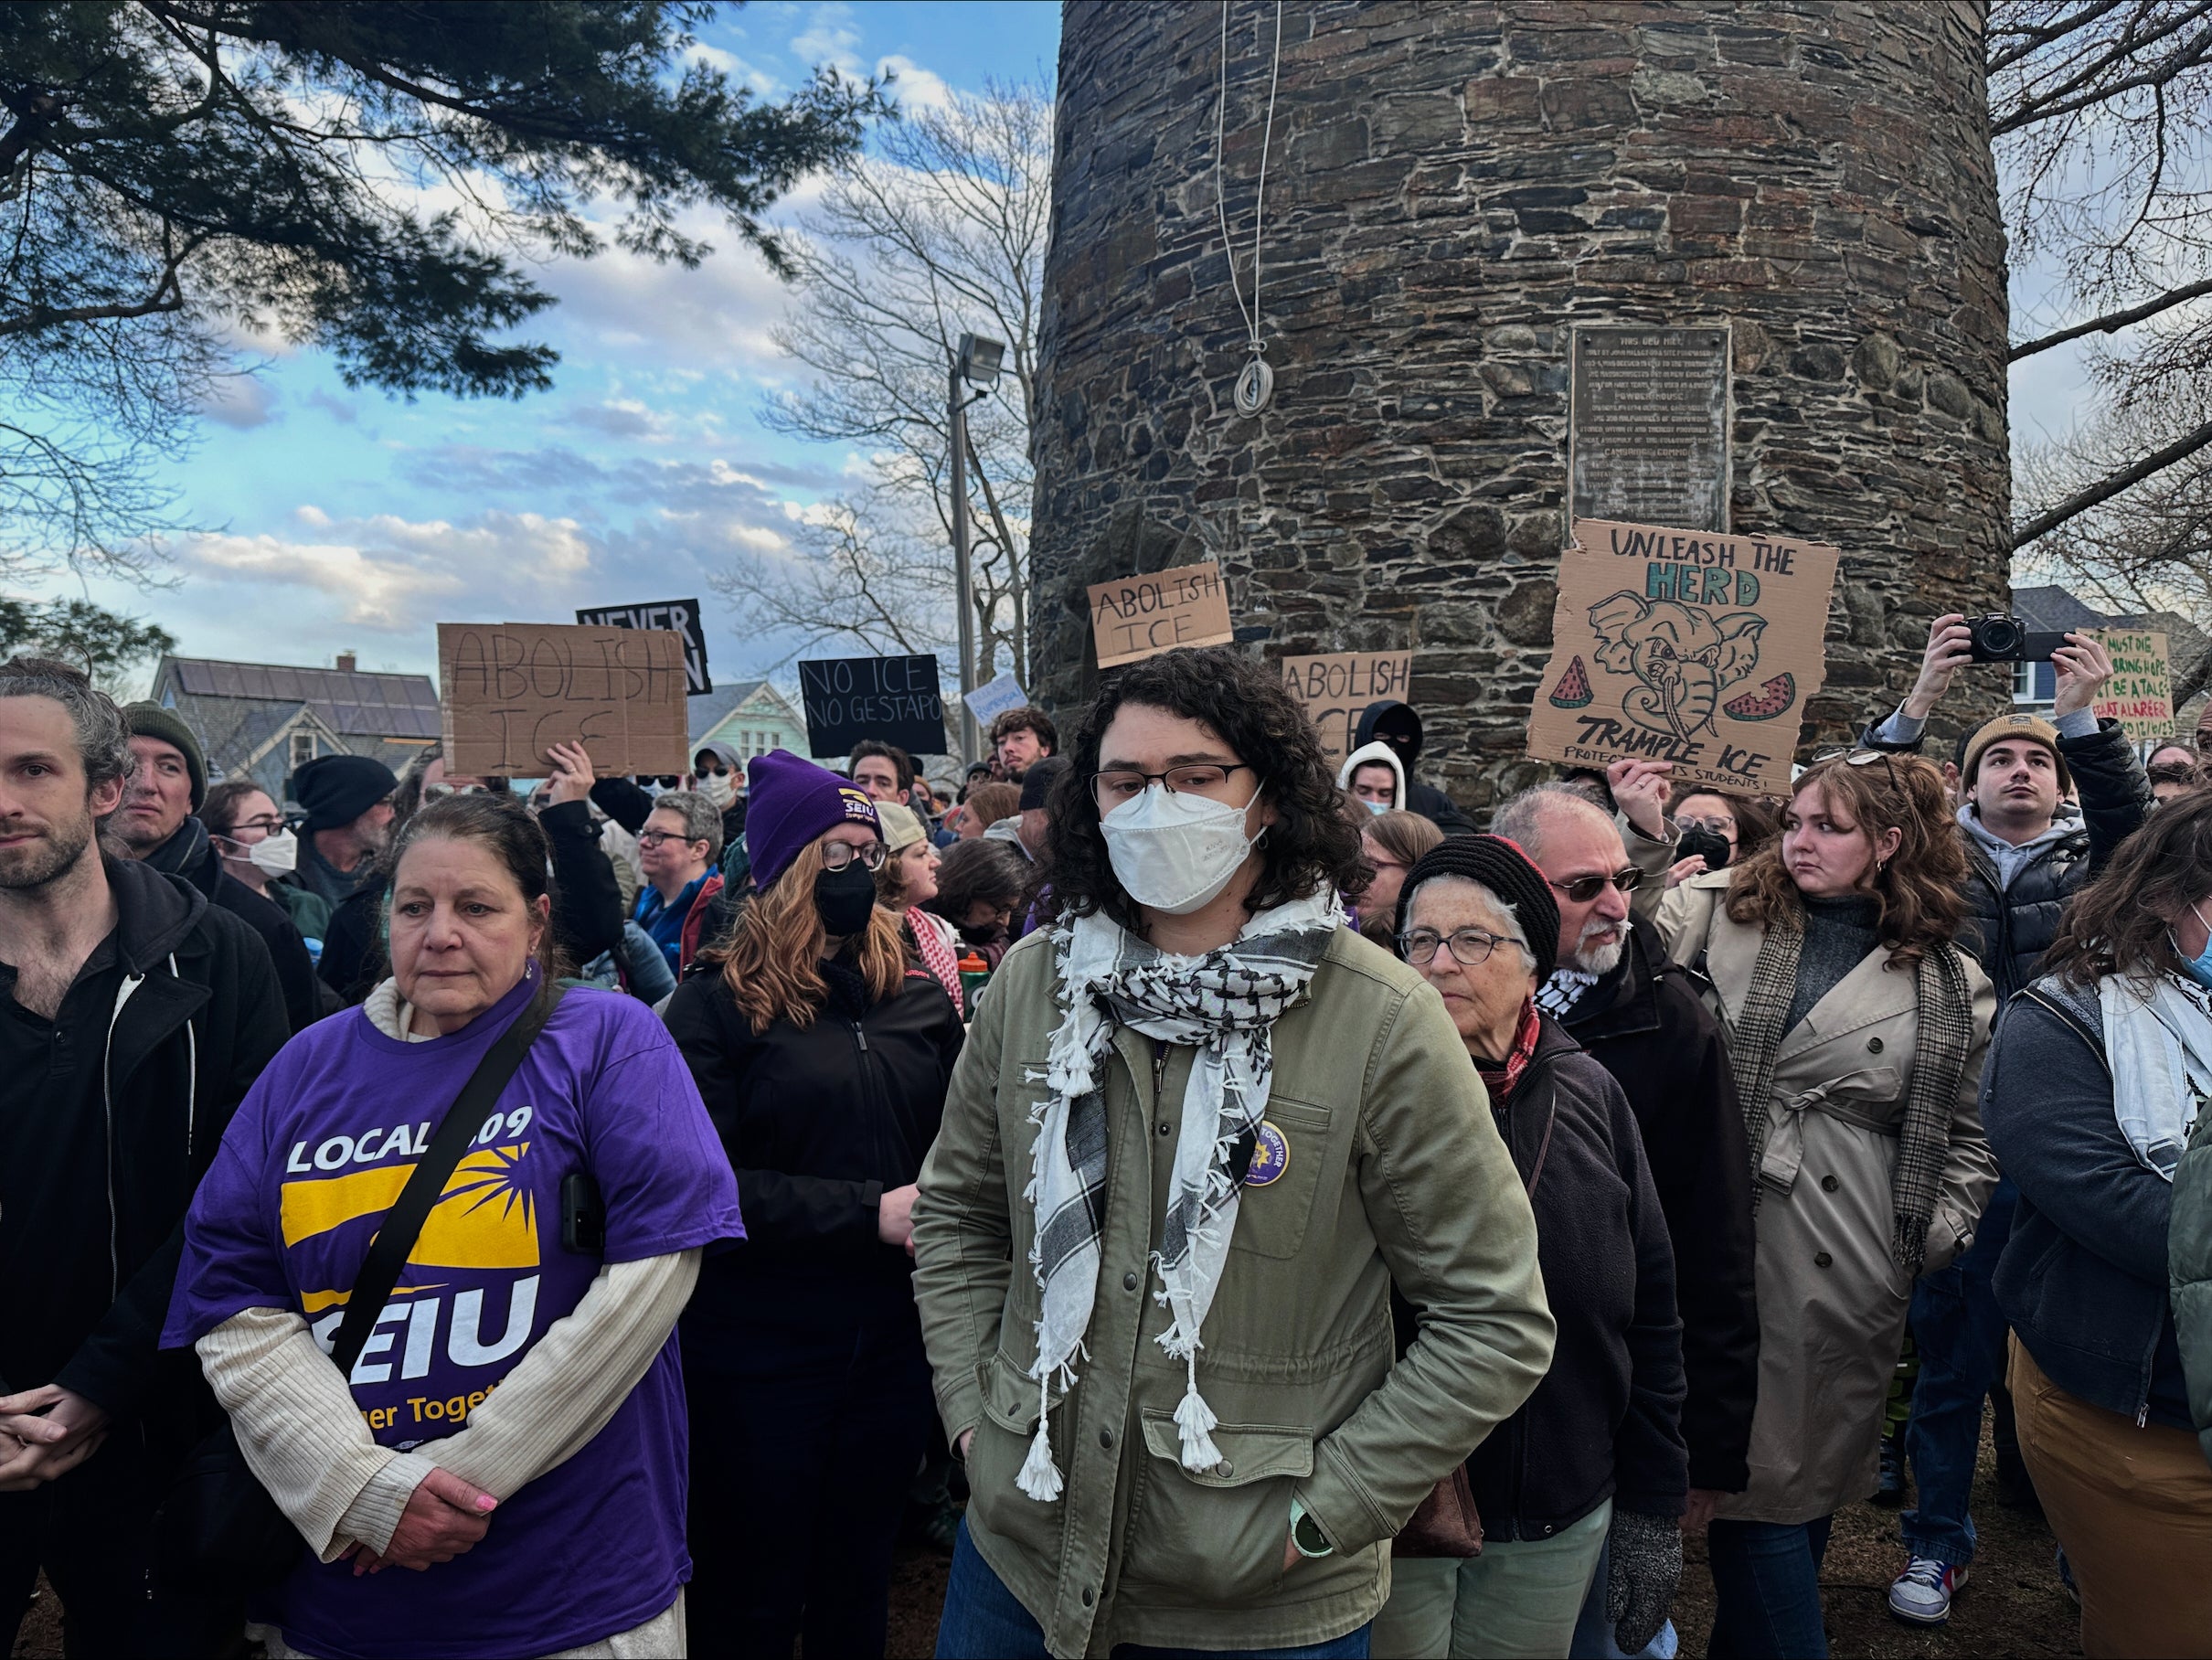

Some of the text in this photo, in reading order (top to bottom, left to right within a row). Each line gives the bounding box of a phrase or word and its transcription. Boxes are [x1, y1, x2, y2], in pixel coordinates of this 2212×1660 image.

[1611, 528, 1797, 576] UNLEASH THE
[1097, 571, 1219, 625] ABOLISH
[1644, 561, 1760, 606] HERD
[583, 605, 696, 648] VER
[1112, 614, 1192, 653] ICE
[2107, 635, 2132, 653] MUST
[2135, 635, 2155, 657] DIE,
[454, 631, 670, 704] ABOLISH
[800, 660, 854, 697] NO
[873, 657, 928, 694] ICE
[1284, 658, 1409, 699] ABOLISH
[2112, 658, 2143, 674] BRING
[2113, 678, 2127, 696] BE
[2132, 680, 2140, 698] A
[805, 693, 942, 729] NO GESTAPO
[490, 709, 613, 770] ICE
[1311, 707, 1367, 757] CE
[1576, 715, 1771, 779] TRAMPLE ICE
[1695, 769, 1768, 791] STUDENTS!
[845, 803, 874, 816] SEIU
[286, 1105, 533, 1173] LOCAL 09
[1260, 1128, 1283, 1168] TOGETHER
